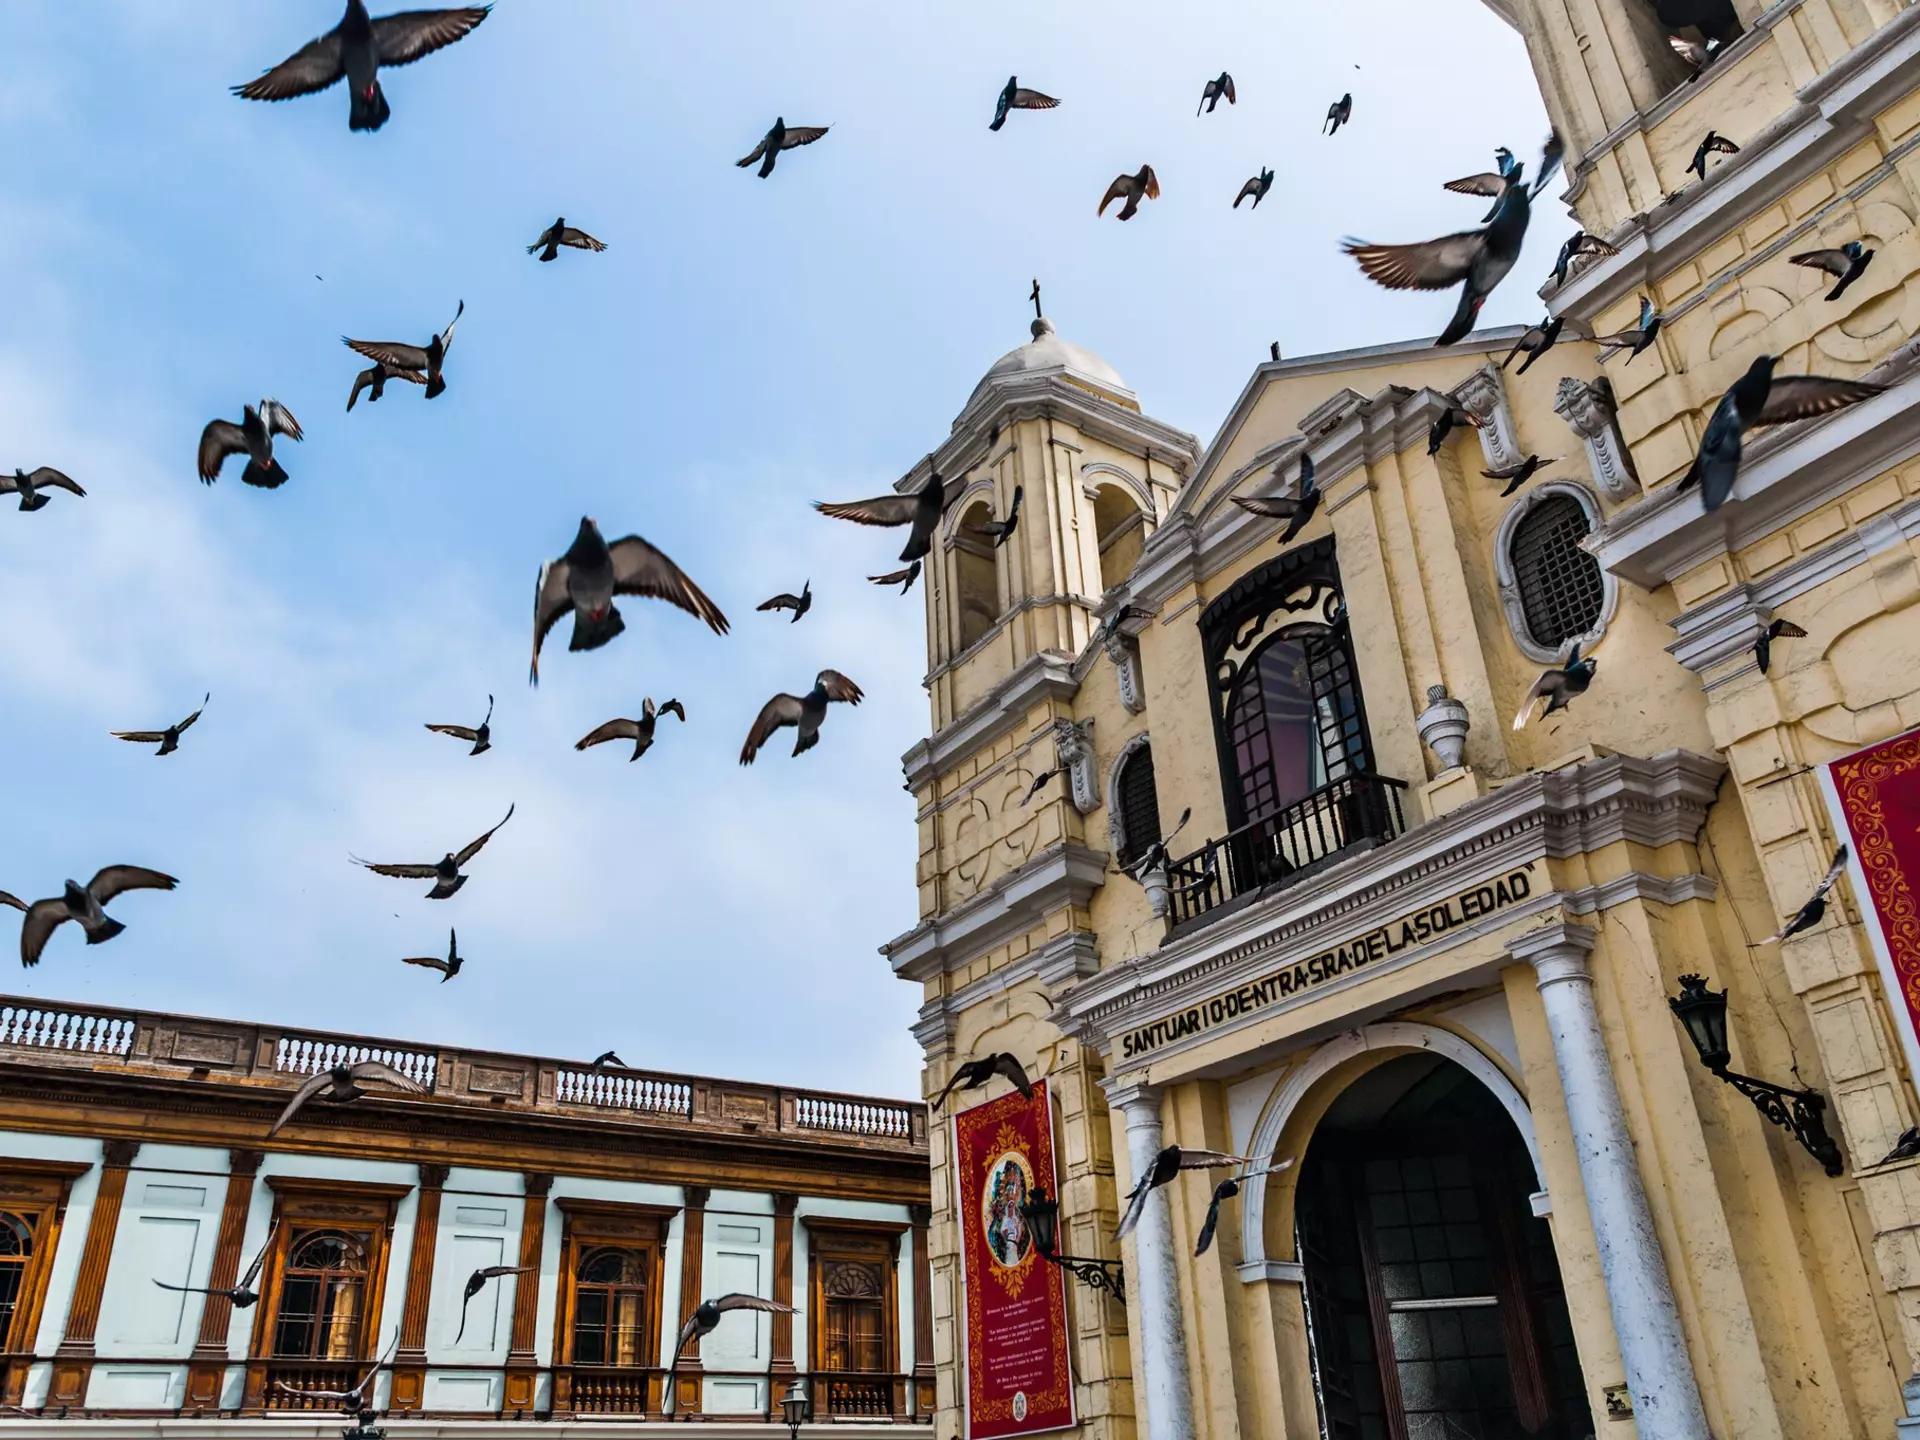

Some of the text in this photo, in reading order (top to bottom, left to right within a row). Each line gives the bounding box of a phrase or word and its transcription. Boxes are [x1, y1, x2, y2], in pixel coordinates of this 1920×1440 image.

[1123, 998, 1224, 1058] SANTUARIO
[1225, 988, 1252, 1018] DE
[1352, 931, 1384, 967] DE
